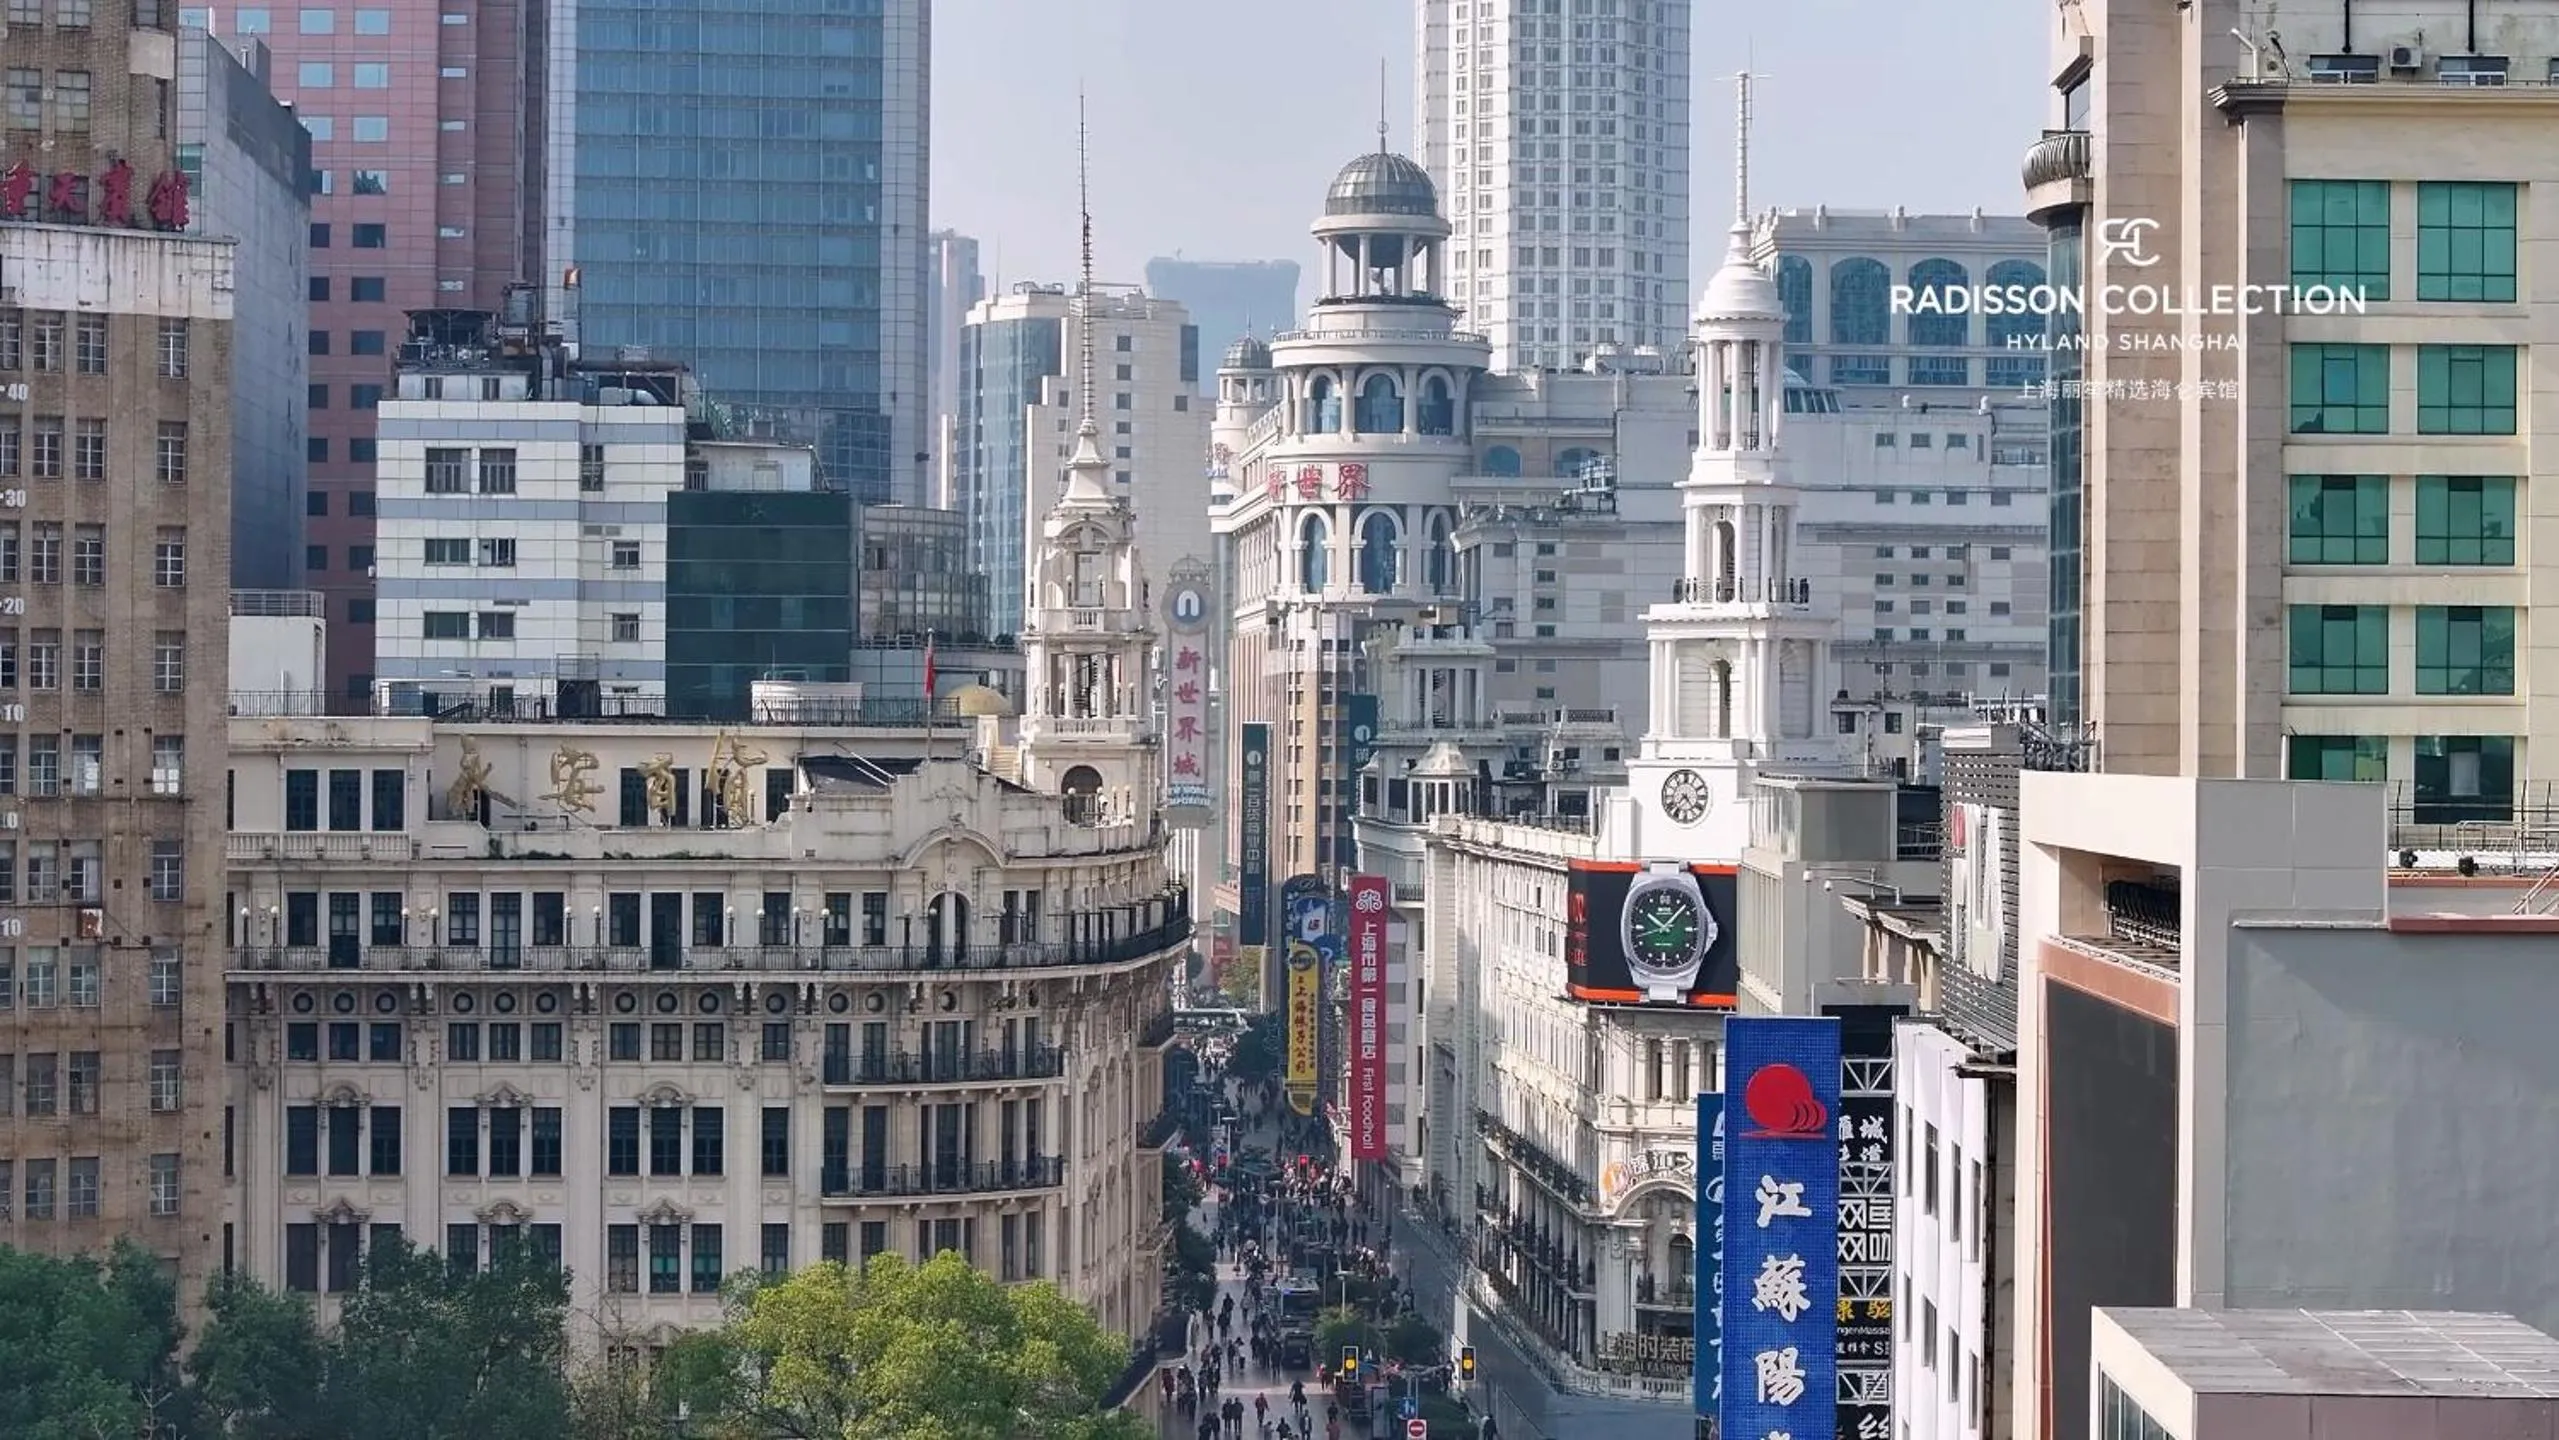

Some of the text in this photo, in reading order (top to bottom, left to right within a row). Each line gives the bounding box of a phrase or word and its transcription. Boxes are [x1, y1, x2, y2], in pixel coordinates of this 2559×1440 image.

[8, 383, 28, 401] 40
[5, 489, 26, 507] 30
[4, 598, 25, 615] 20
[1174, 646, 1202, 779] 新世界城
[1362, 1067, 1375, 1091] First
[1752, 1175, 1813, 1440] 江蘇陽
